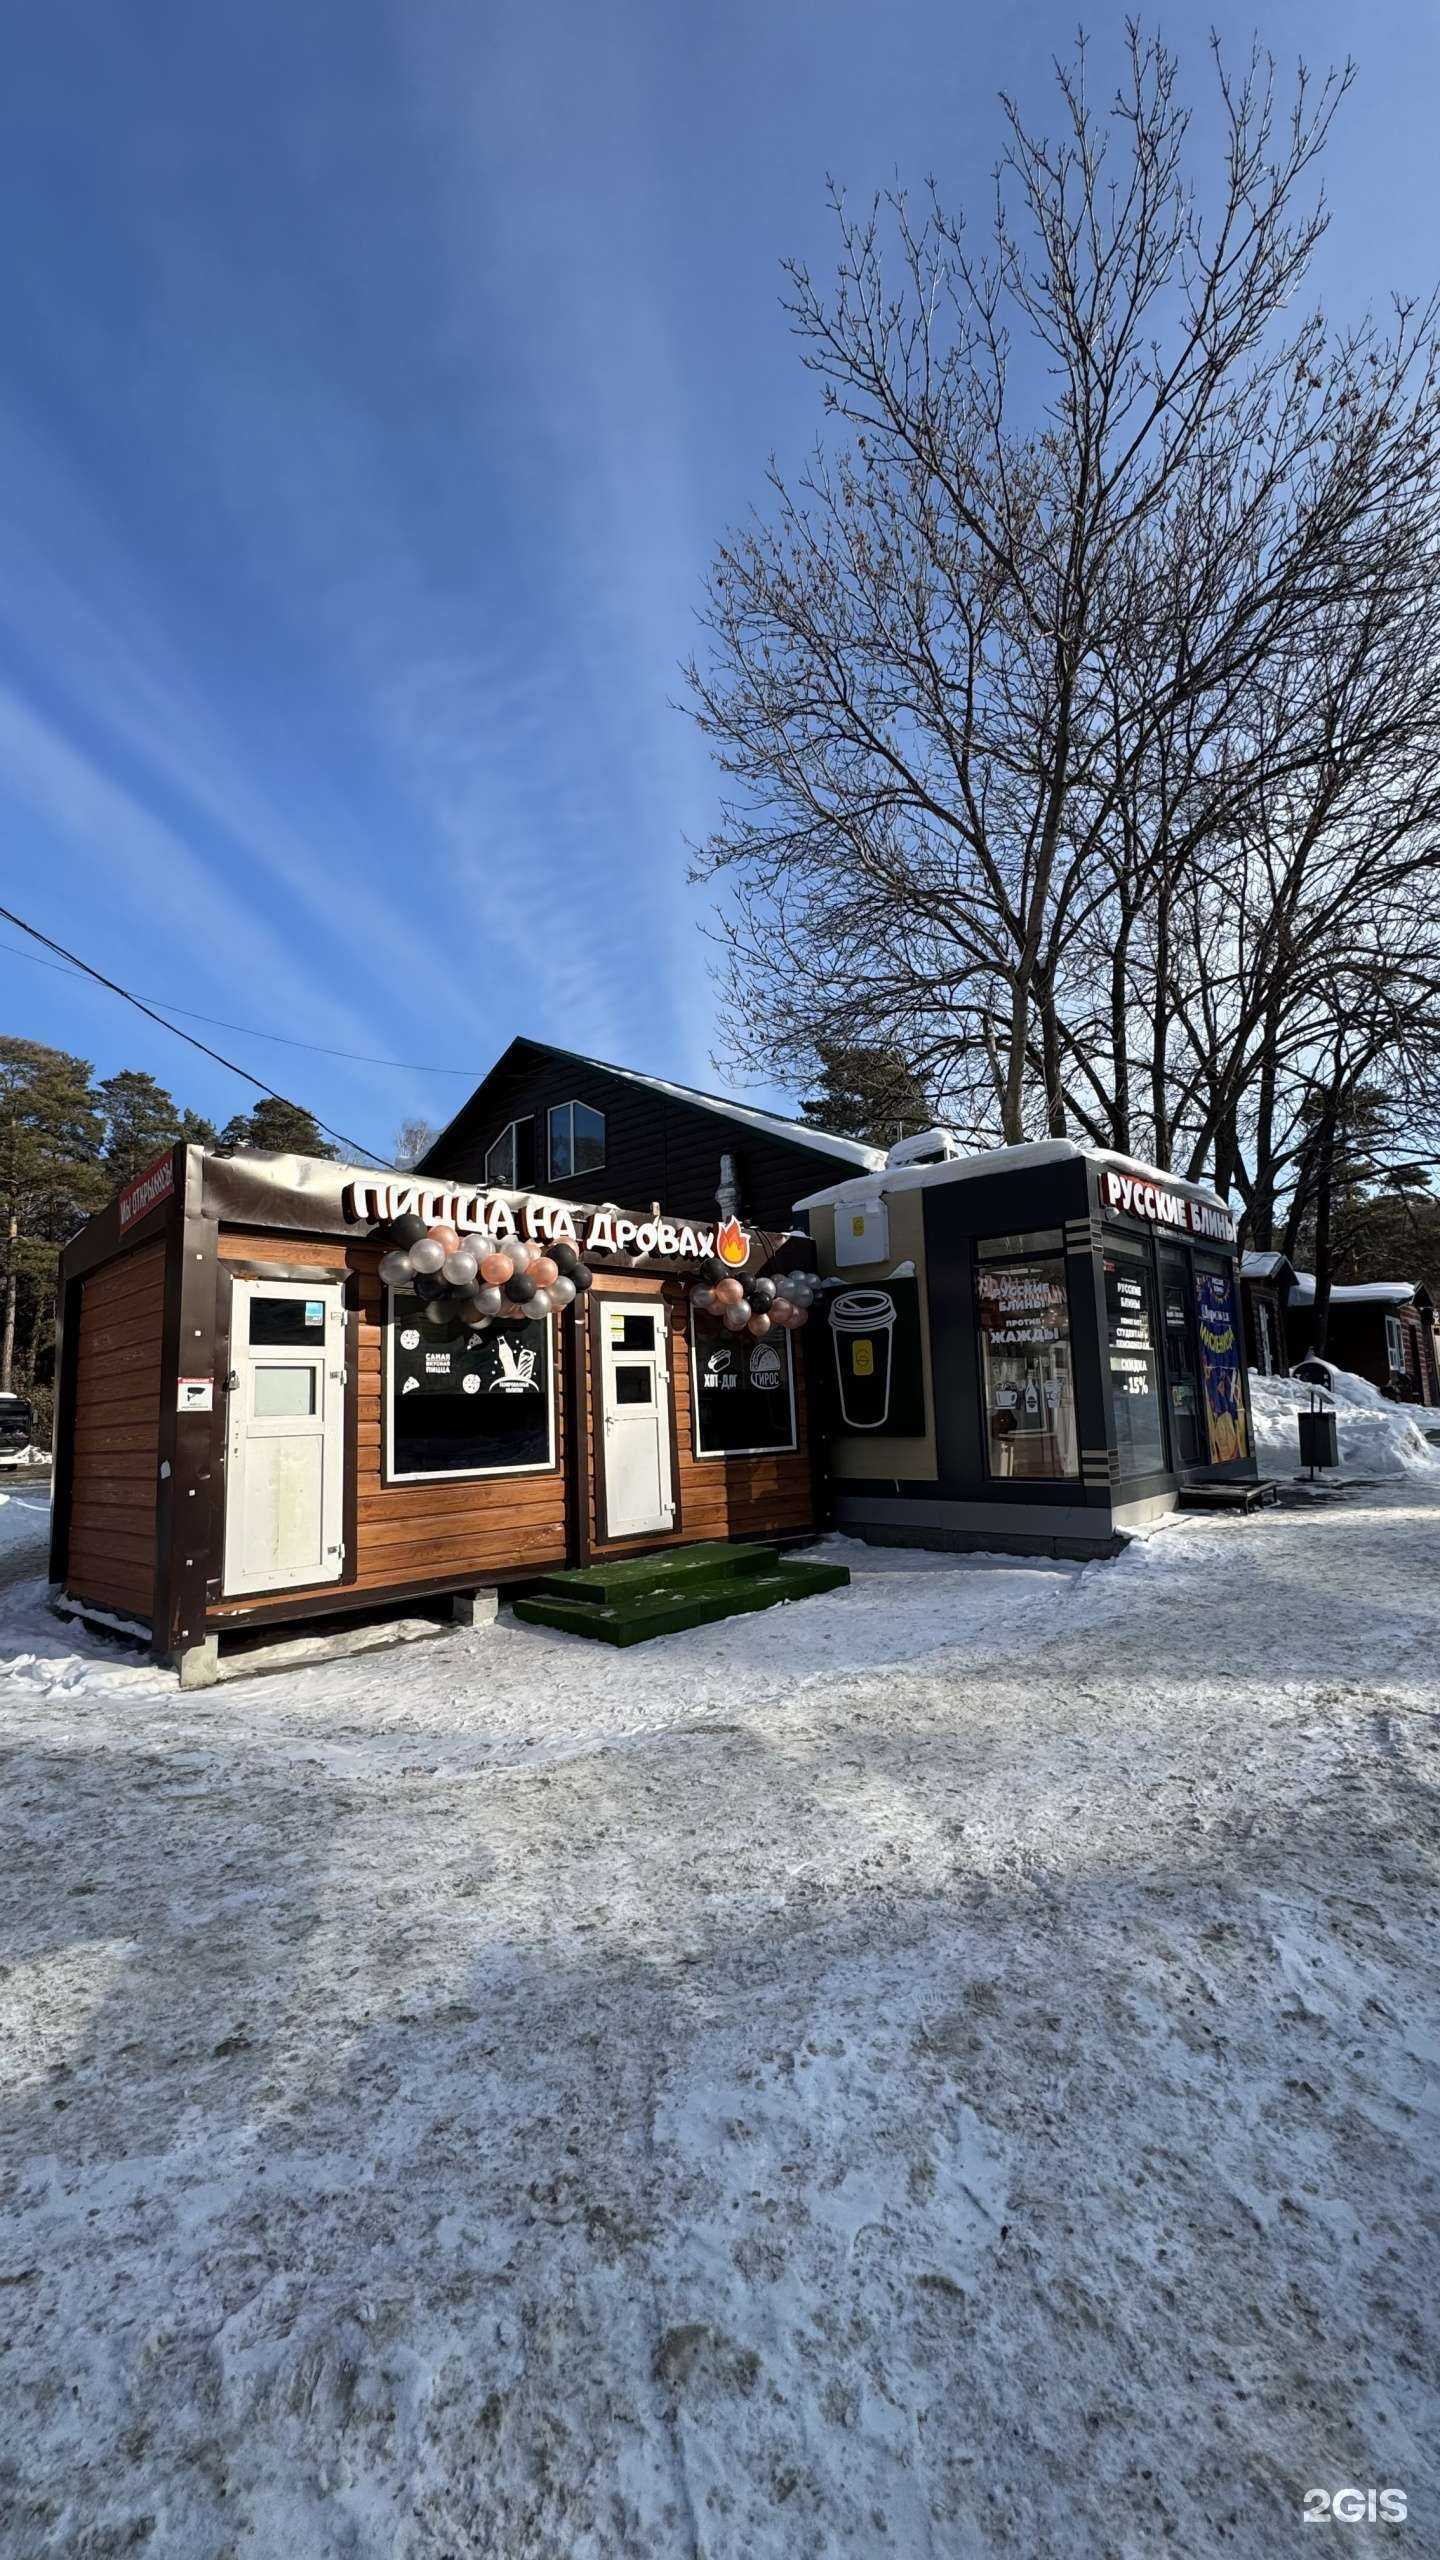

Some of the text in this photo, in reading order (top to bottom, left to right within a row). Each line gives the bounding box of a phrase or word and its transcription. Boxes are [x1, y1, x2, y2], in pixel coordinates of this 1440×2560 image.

[1107, 1171, 1237, 1243] РУССКИЕ БЛИНЫ
[353, 1181, 715, 1259] ПИЦЦА НА ДРОВАХ
[990, 1327, 1059, 1344] ЖАЖДЫ
[703, 1373, 738, 1391] ХОТ-ДОГ
[755, 1372, 780, 1386] ГИРОС
